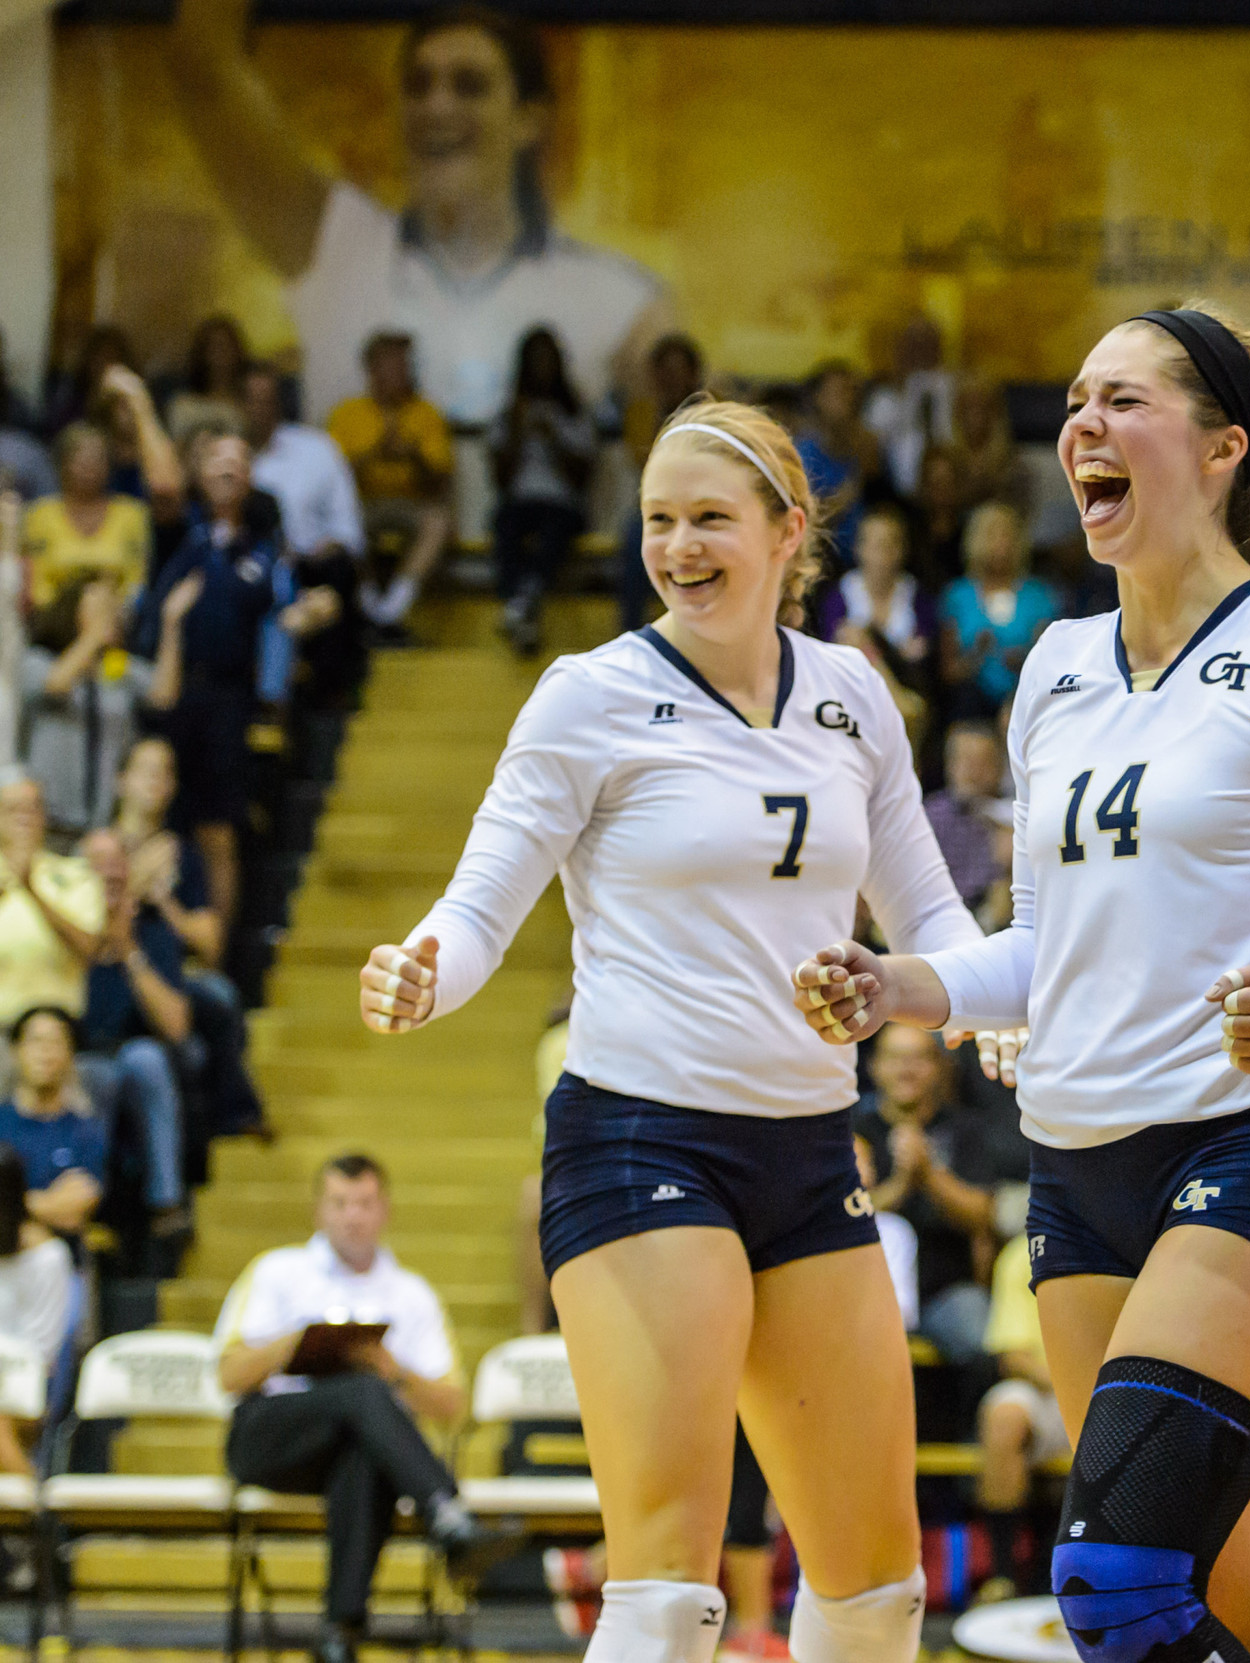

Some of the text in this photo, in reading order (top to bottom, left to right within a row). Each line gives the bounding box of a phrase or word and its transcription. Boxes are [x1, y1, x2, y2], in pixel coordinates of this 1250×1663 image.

[1050, 685, 1081, 695] RUSSELL
[761, 793, 810, 879] 7
[1057, 759, 1151, 867] 14
[1172, 1179, 1221, 1212] GT
